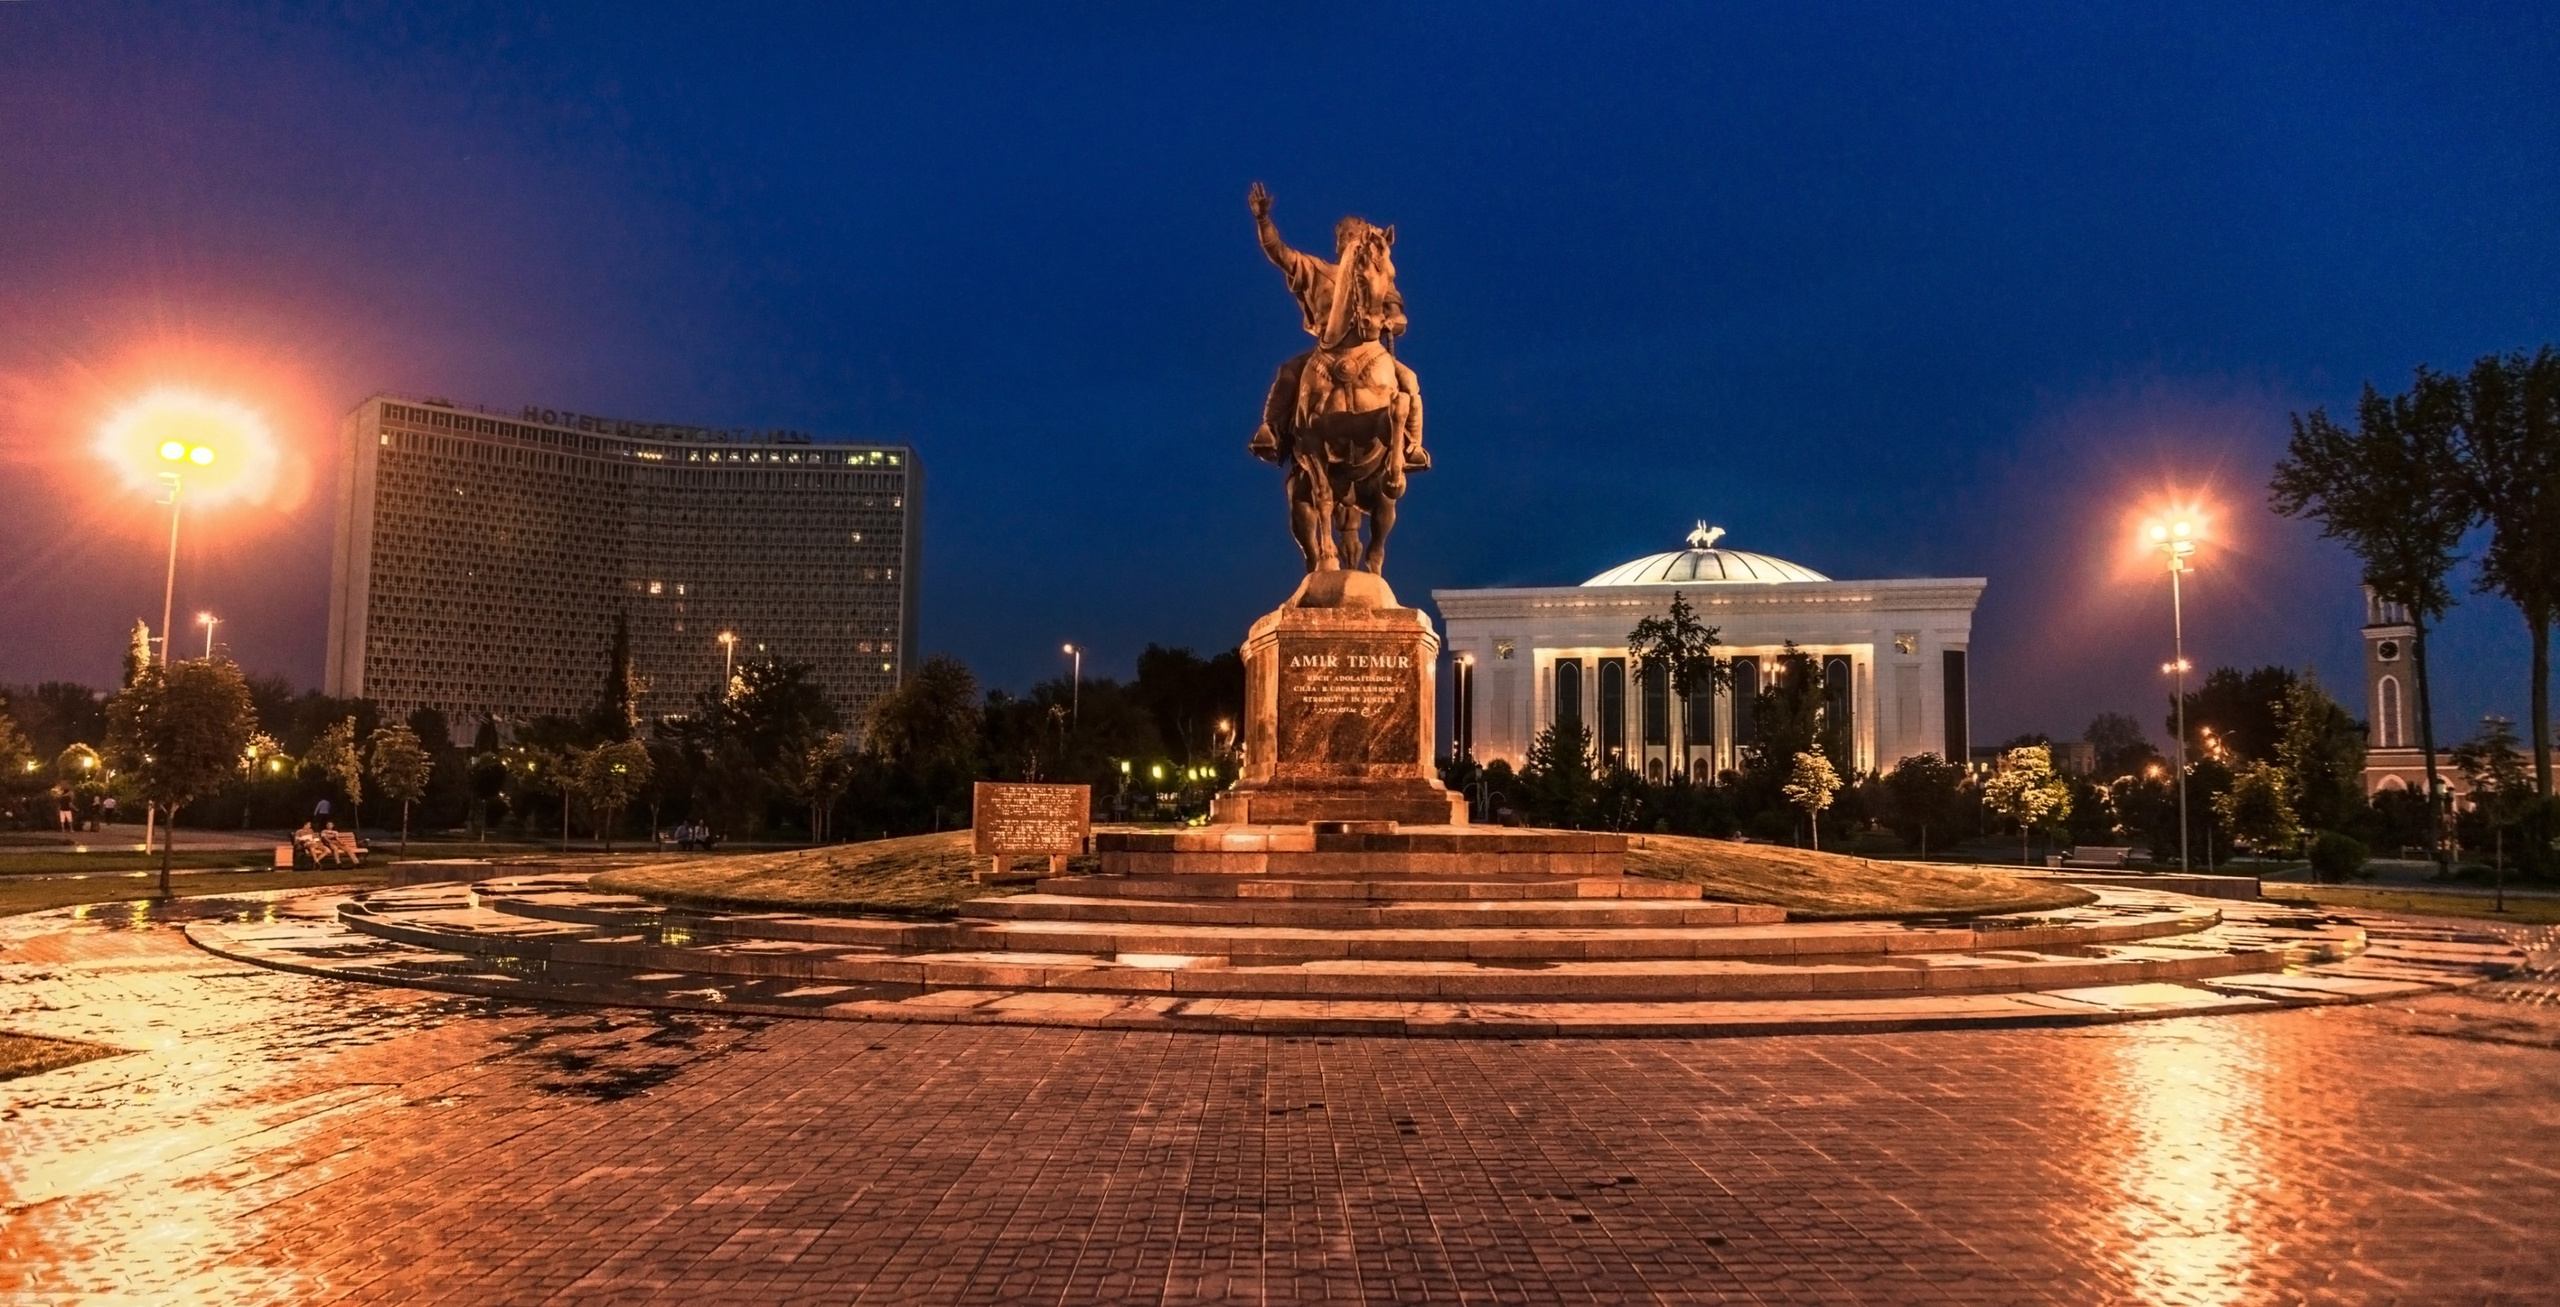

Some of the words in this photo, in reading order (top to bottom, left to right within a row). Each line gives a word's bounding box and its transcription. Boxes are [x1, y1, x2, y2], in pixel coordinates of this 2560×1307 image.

[523, 405, 609, 433] HOTEL
[1290, 655, 1338, 668] AMIR
[1347, 655, 1410, 668] TEMUR
